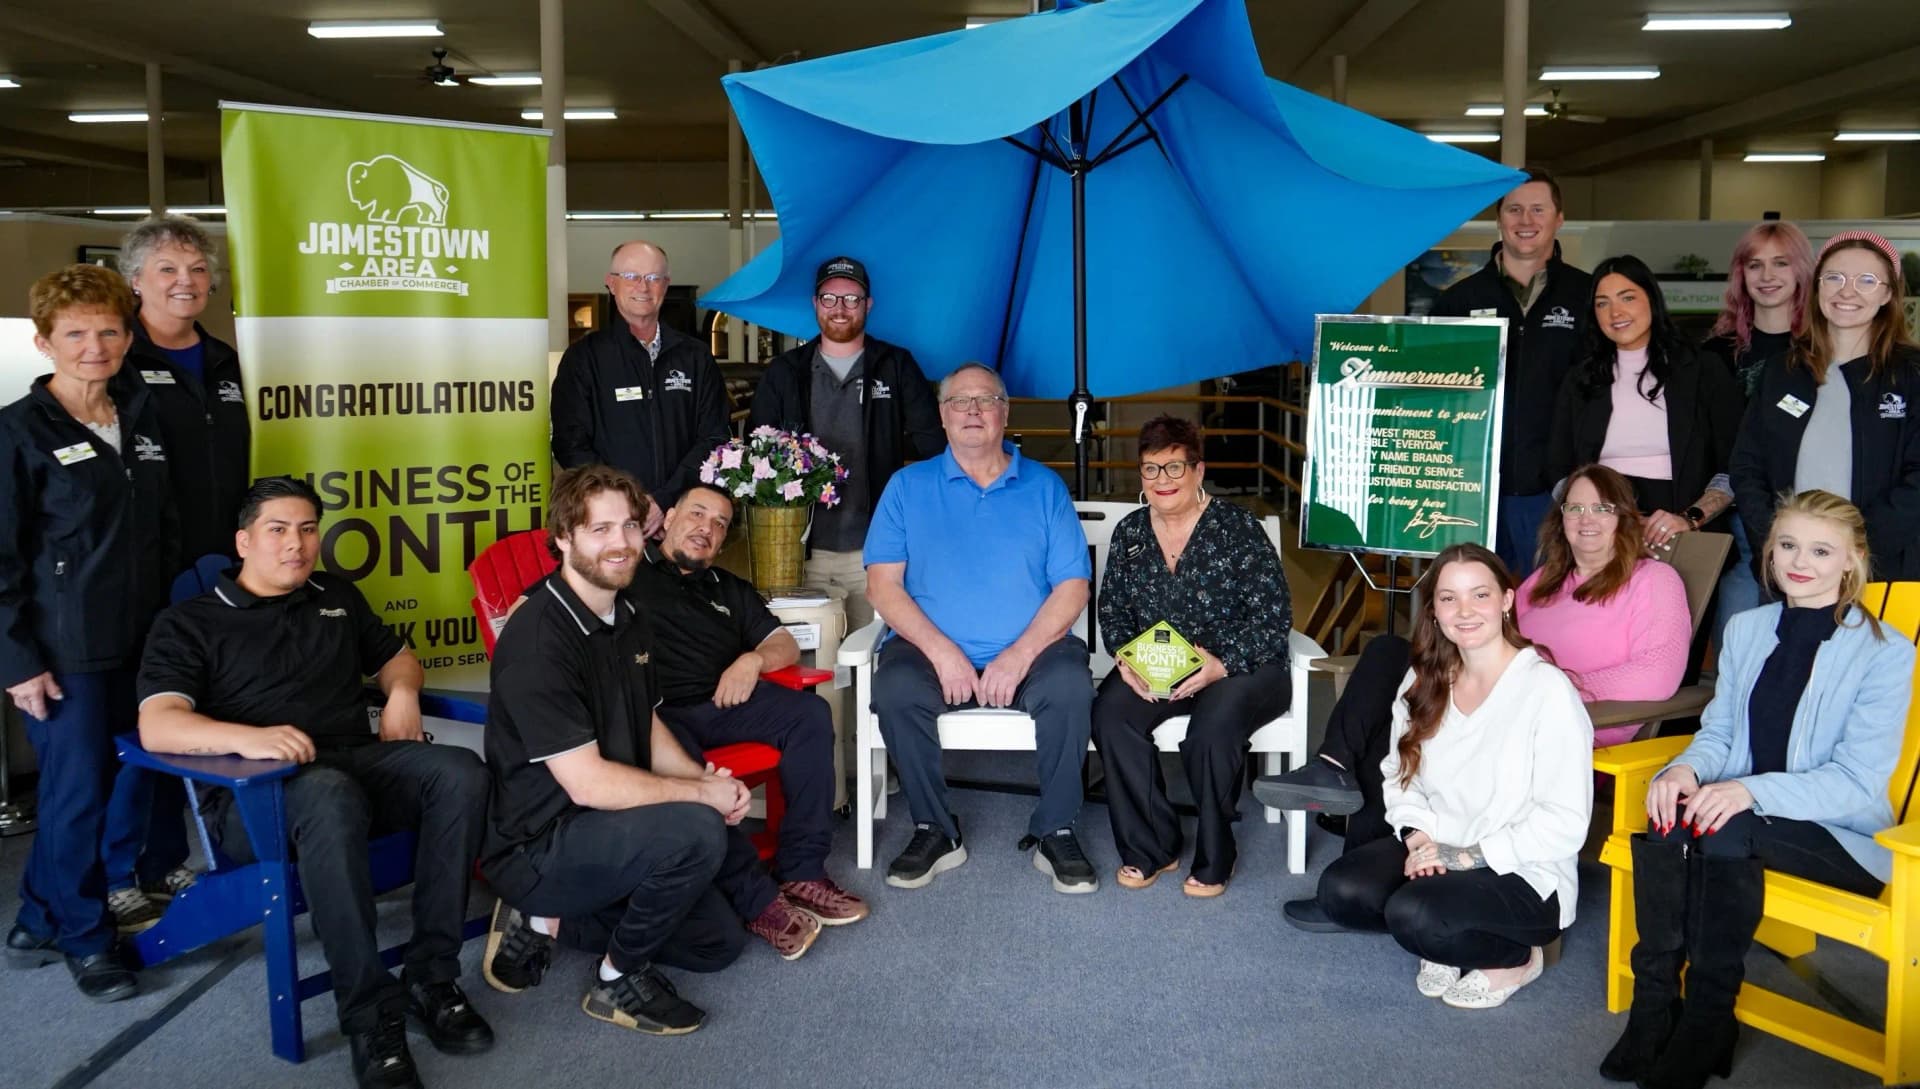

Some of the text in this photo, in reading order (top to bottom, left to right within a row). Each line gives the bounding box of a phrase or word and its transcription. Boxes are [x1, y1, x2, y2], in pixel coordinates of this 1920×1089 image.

[298, 222, 489, 260] JAMESTOWN
[361, 257, 437, 278] AREA
[339, 279, 389, 288] CHAMBER
[402, 279, 459, 290] COMMERCE
[1330, 341, 1375, 353] Welcome
[1331, 357, 1485, 391] Zimmerman's
[258, 380, 535, 421] CONGRATULATIONS
[1359, 405, 1433, 419] mmitment
[1437, 408, 1450, 419] to
[1452, 410, 1487, 423] you!
[1359, 427, 1401, 438] OWEST
[1402, 429, 1436, 439] PRICES
[1380, 452, 1409, 461] NAME
[1412, 453, 1453, 464] BRANDS
[1378, 464, 1421, 475] FRIENDLY
[1424, 467, 1464, 478] SERVICE
[254, 461, 535, 512] SINESS OF
[1362, 477, 1412, 488] USTOMER
[1415, 479, 1482, 493] SATISFACTION
[496, 484, 541, 505] THE
[1388, 495, 1418, 509] being
[1422, 497, 1447, 508] here
[319, 507, 542, 582] ONT
[384, 599, 418, 612] AND
[425, 616, 477, 647] YOU
[1136, 652, 1186, 668] MONTH
